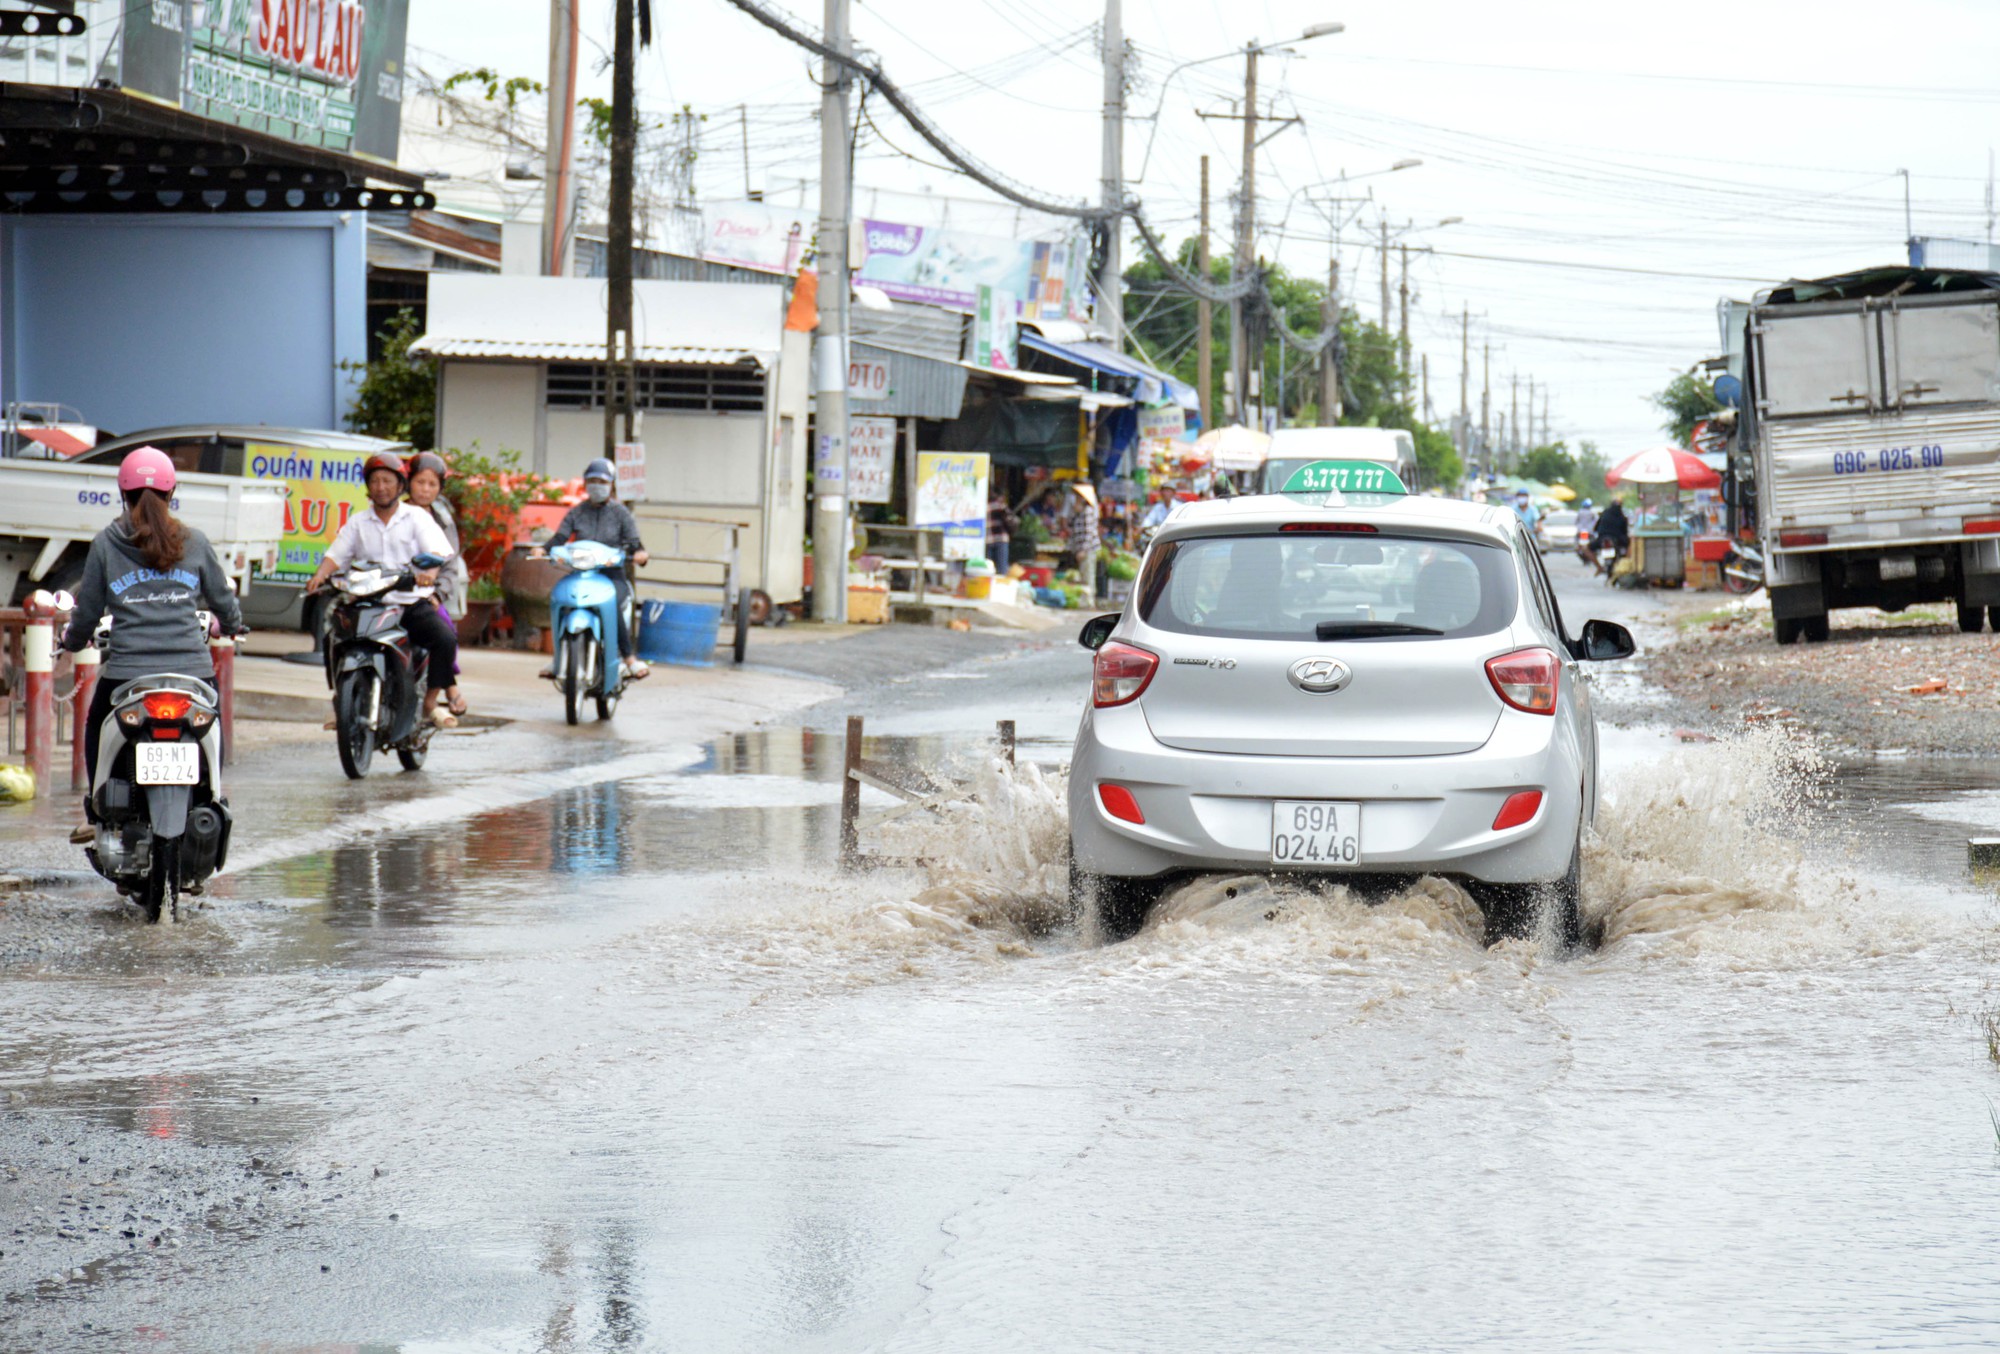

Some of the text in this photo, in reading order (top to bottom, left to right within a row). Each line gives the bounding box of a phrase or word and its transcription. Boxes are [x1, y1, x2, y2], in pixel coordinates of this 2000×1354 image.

[252, 451, 365, 488] QUÁN NHẬ
[1834, 445, 1943, 475] 69C-025.90
[1303, 468, 1385, 489] 3.777 777
[109, 568, 200, 595] BLUE EXANGE
[1209, 656, 1237, 670] i10
[1294, 805, 1338, 832] 69A
[1275, 833, 1356, 862] 024.46
